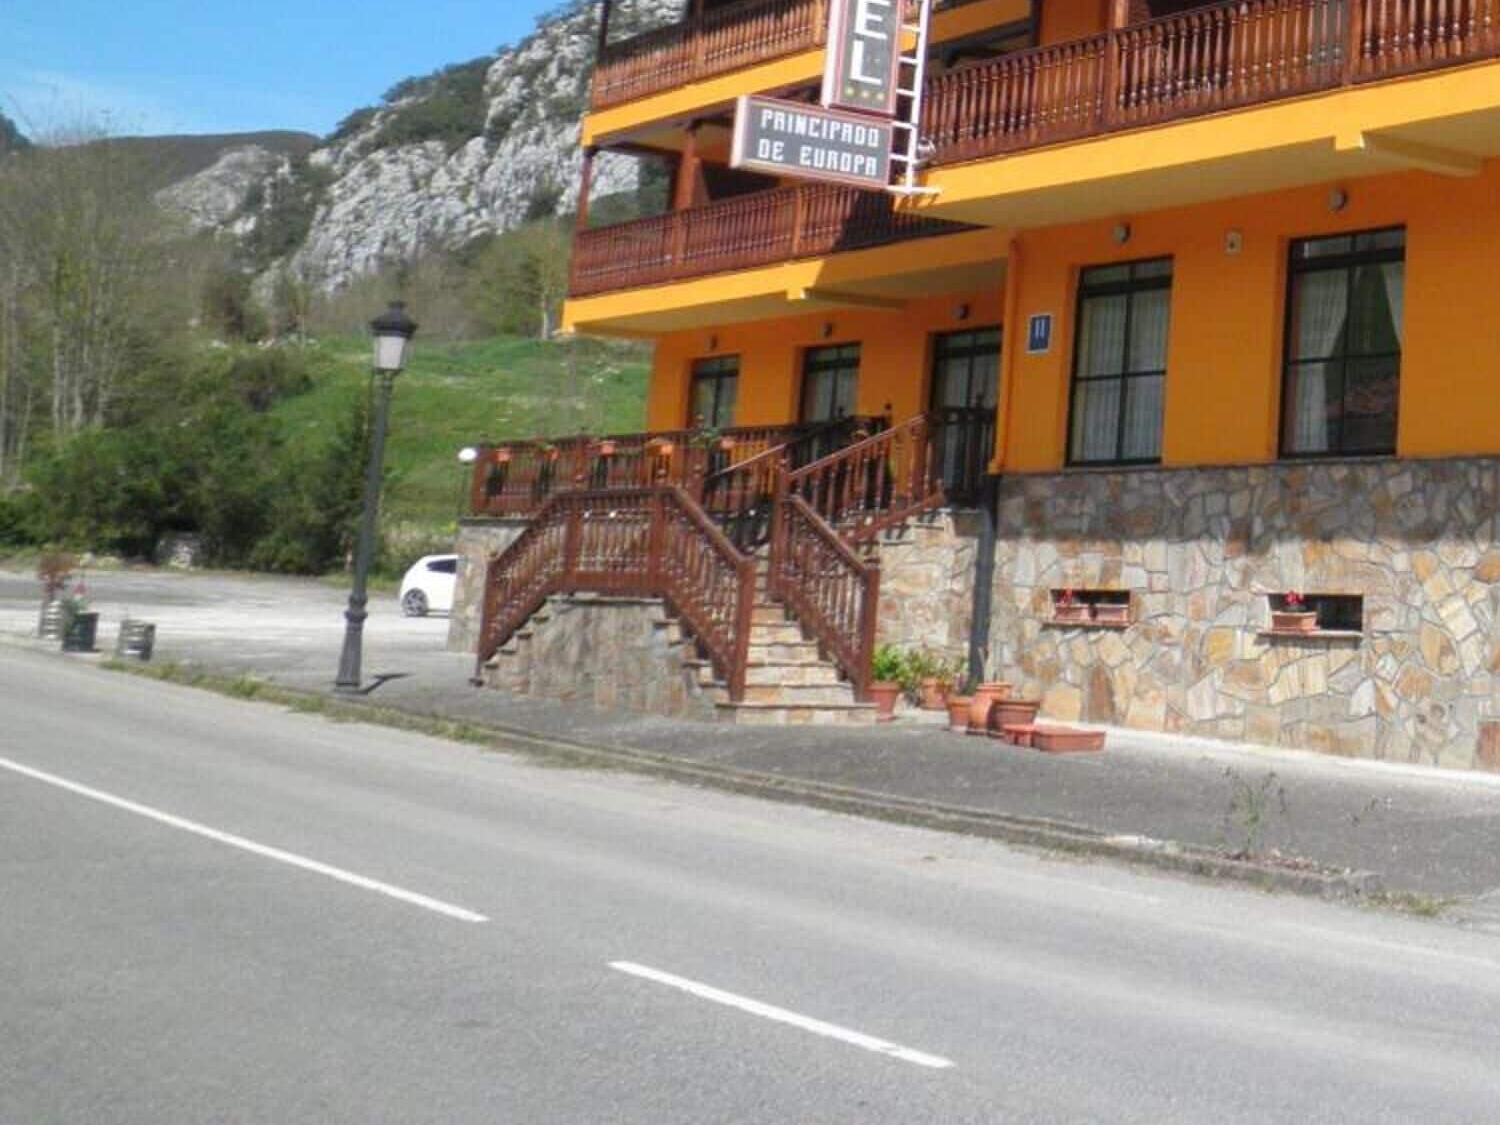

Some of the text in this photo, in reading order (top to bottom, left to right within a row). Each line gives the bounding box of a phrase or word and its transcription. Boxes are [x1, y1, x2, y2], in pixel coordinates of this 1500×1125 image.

[761, 109, 880, 147] PRINCIPADO
[757, 138, 878, 176] DE EUROPA
